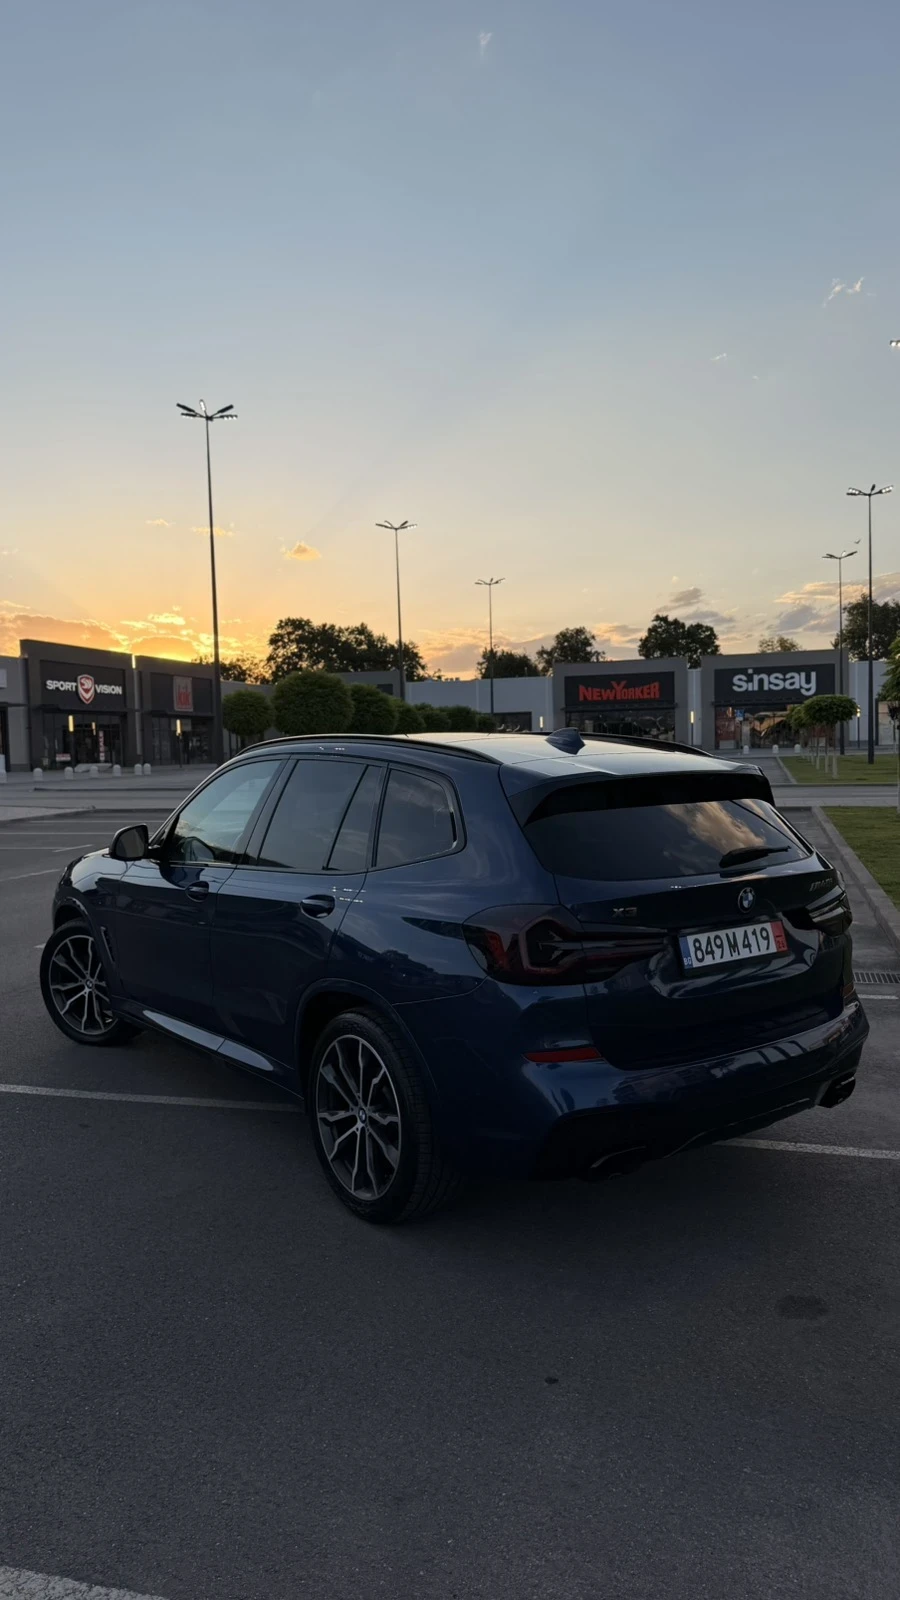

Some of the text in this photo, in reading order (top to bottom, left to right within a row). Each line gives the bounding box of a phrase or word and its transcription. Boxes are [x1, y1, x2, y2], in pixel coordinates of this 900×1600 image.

[46, 680, 76, 692] SPORT
[95, 684, 122, 695] VISION
[732, 669, 817, 696] sinsay
